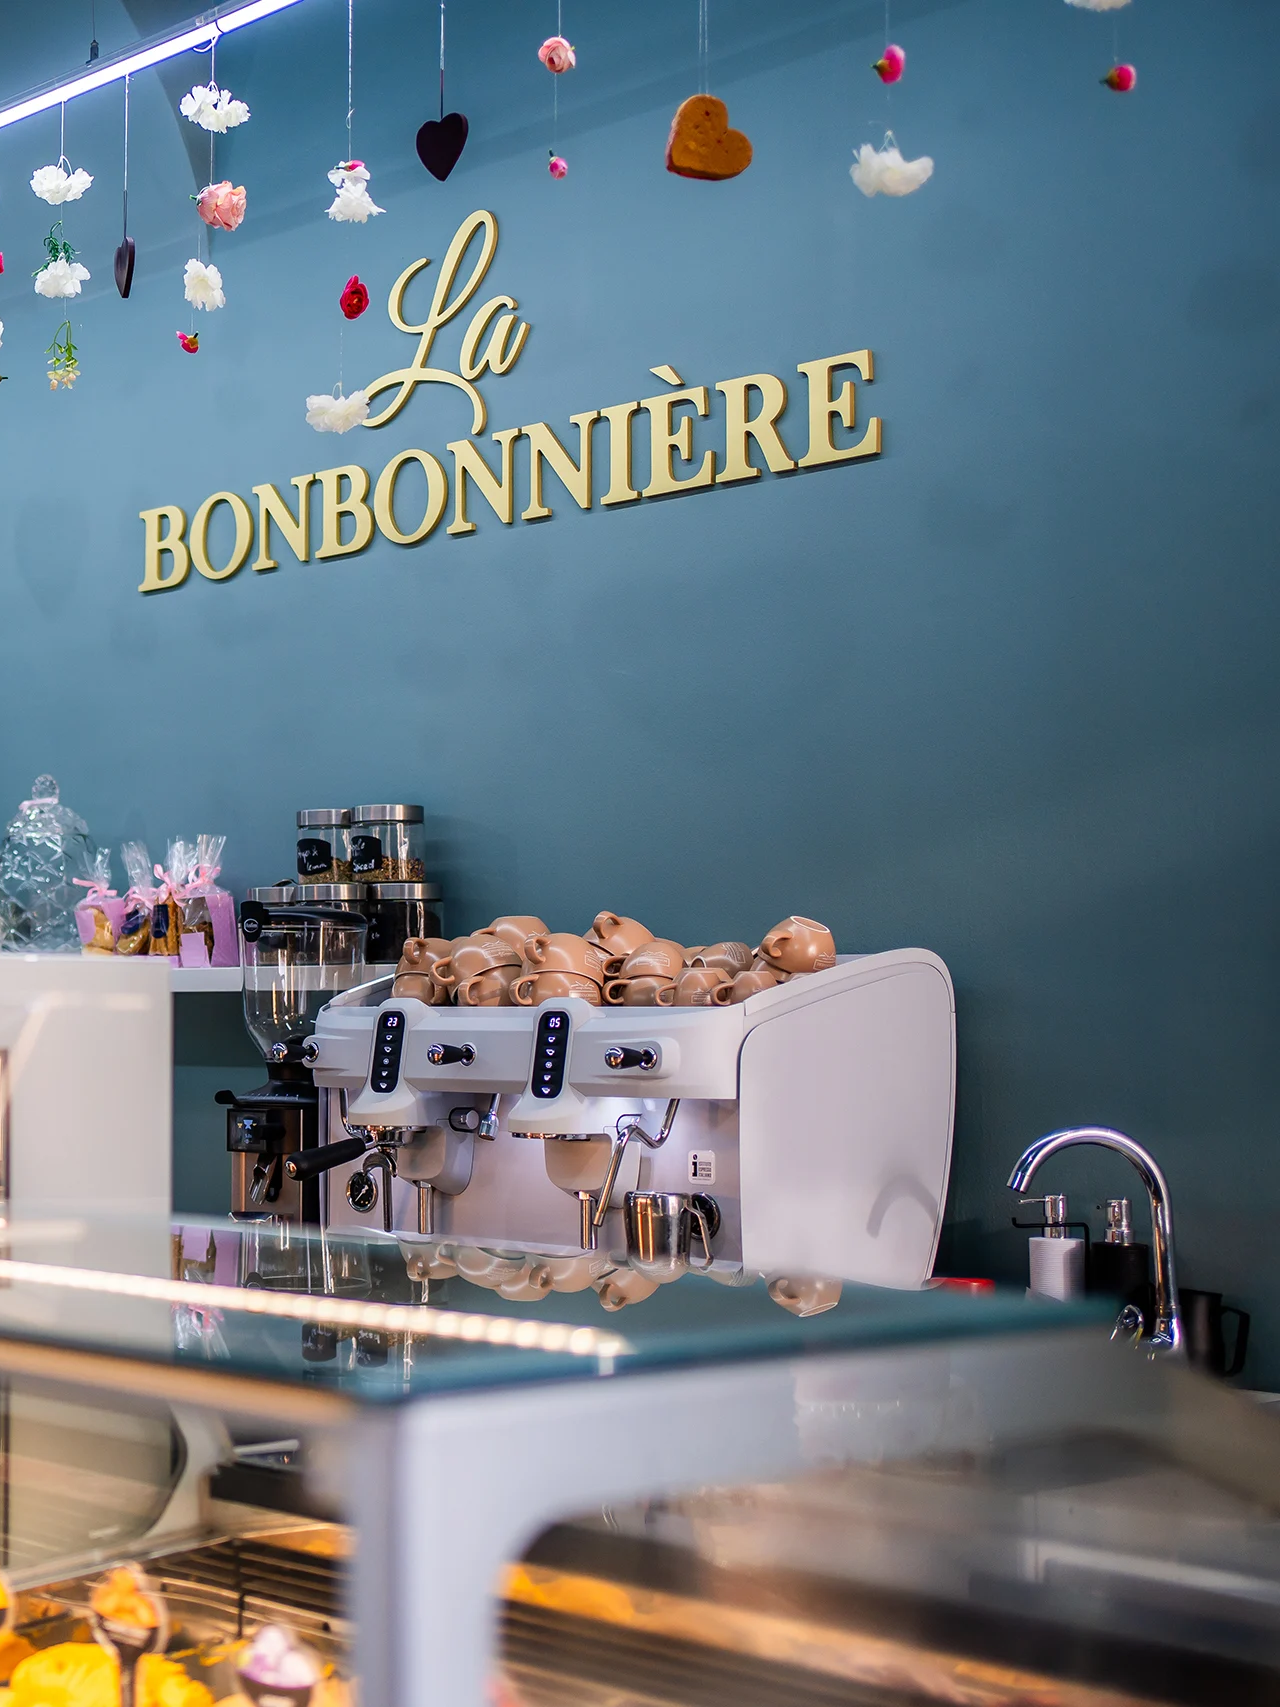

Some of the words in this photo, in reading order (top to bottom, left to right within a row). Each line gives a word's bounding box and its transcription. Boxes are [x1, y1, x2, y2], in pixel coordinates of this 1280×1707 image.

[361, 209, 531, 436] La
[138, 348, 883, 593] BONBONNIÈRE
[387, 1017, 398, 1027] 23
[549, 1017, 561, 1028] 05
